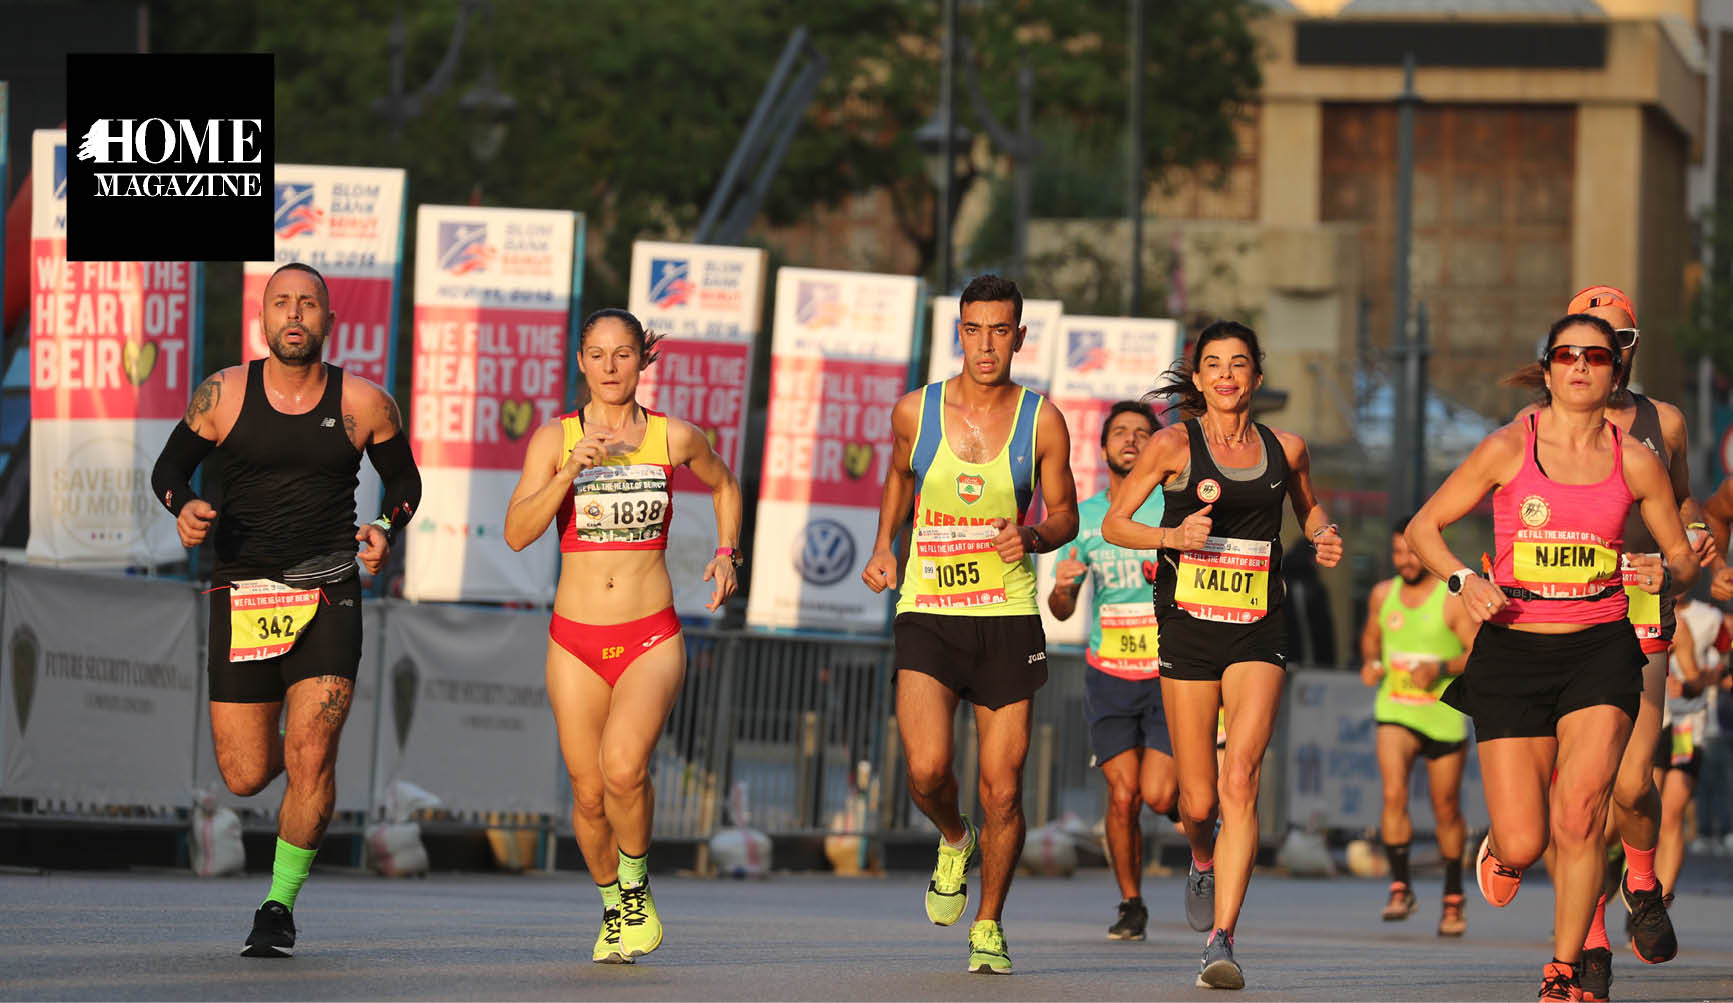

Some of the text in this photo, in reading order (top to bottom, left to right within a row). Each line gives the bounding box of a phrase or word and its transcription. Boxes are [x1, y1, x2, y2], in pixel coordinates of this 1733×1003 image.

[36, 255, 187, 290] WE FILL THE
[35, 293, 187, 336] HEART OF
[417, 321, 562, 356] WE FILL THE
[414, 353, 561, 397] HEART OF
[663, 353, 705, 383] FILL
[707, 356, 745, 386] THE
[708, 387, 743, 425] OF
[602, 482, 612, 491] THE
[612, 481, 634, 491] HEART
[634, 481, 642, 489] OF
[611, 500, 663, 525] 1838
[1517, 529, 1528, 539] WE
[1528, 530, 1543, 539] FILL
[1544, 530, 1558, 539] THE
[1558, 531, 1580, 540] HEART
[1581, 532, 1590, 540] OF
[919, 545, 928, 553] WE
[928, 545, 937, 553] FILL
[937, 545, 947, 553] THE
[947, 543, 966, 553] HEART
[967, 543, 975, 551] OF
[1183, 551, 1193, 560] WE
[1193, 553, 1206, 562] FILL
[1207, 555, 1219, 564] THE
[1219, 556, 1240, 566] HEART
[1240, 558, 1248, 567] OF
[1535, 546, 1595, 567] NJEIM
[935, 560, 980, 588] 1055
[1194, 567, 1254, 594] KALOT
[234, 598, 244, 607] WE
[244, 597, 256, 606] FILL
[257, 596, 268, 605] THE
[1250, 598, 1258, 606] 41
[257, 615, 295, 640] 342
[602, 646, 625, 660] ESP
[1120, 634, 1147, 654] 964
